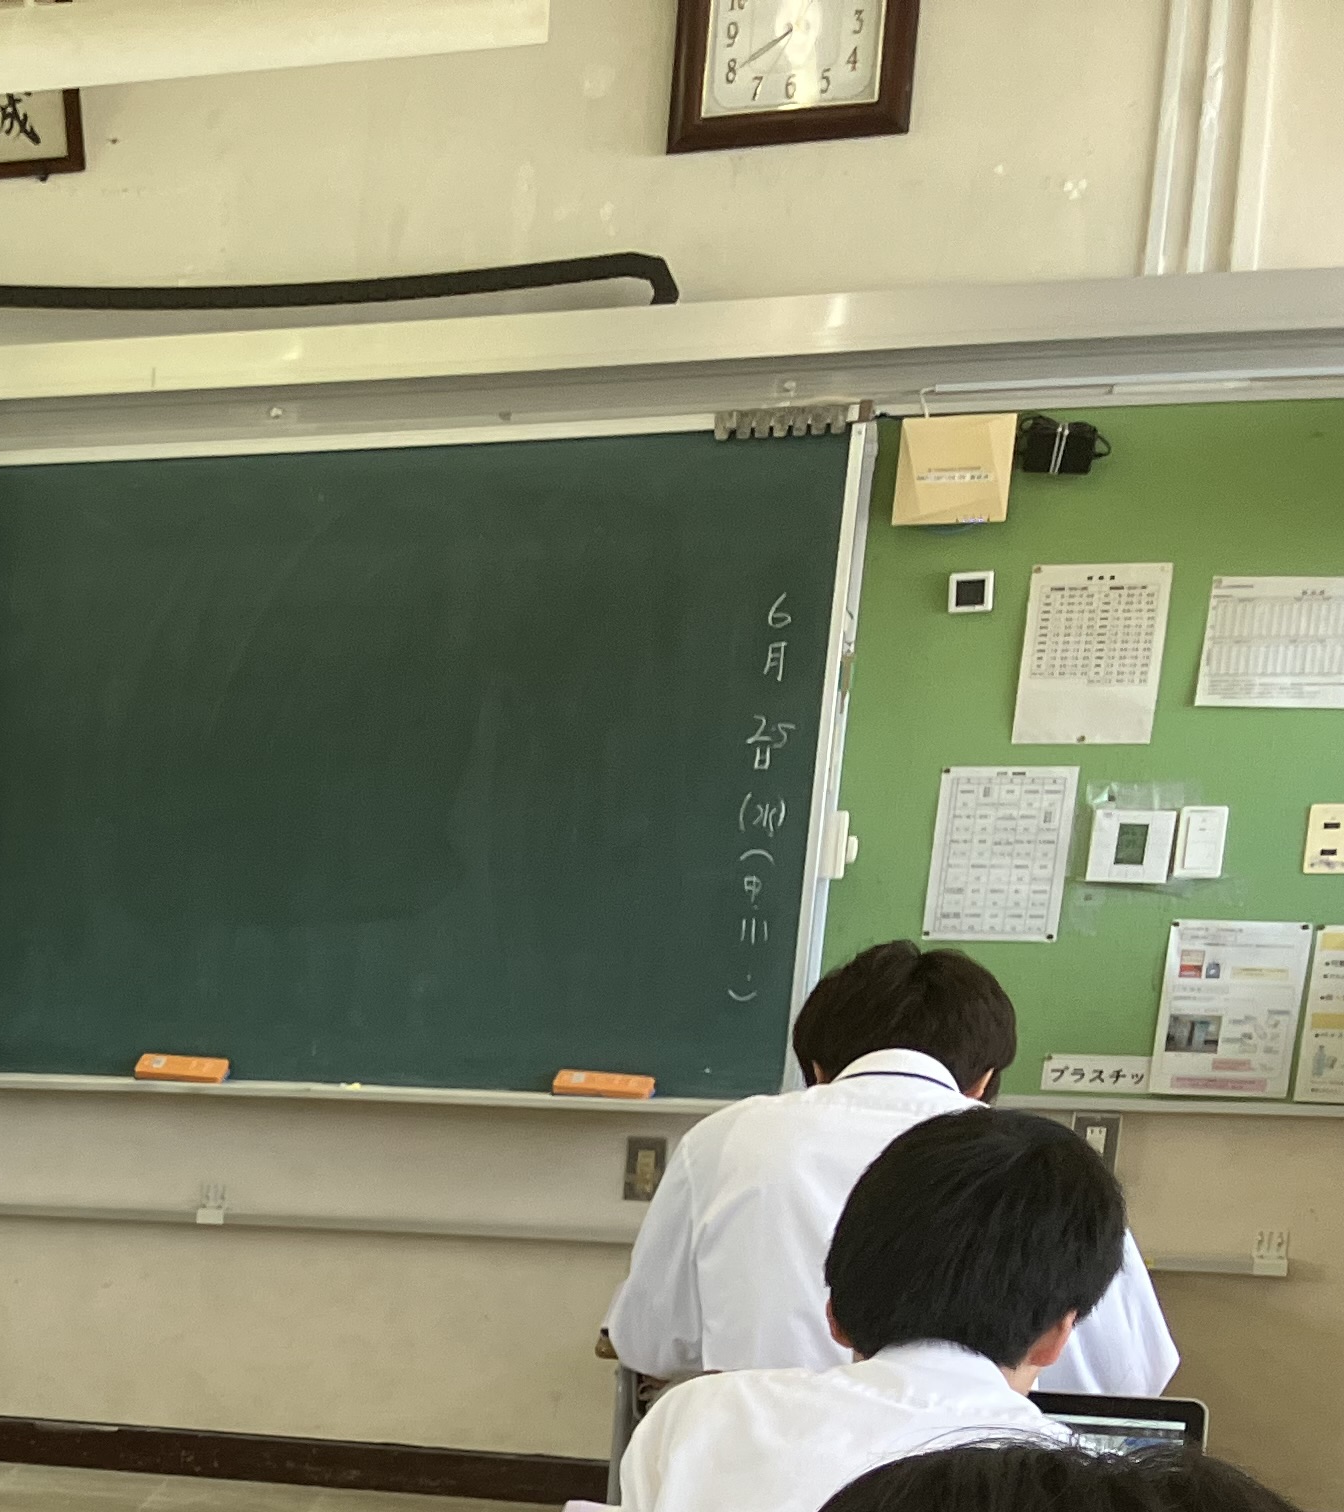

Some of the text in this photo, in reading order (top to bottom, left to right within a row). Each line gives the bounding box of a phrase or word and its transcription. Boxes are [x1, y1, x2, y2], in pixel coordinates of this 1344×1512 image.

[726, 21, 739, 48] 9
[725, 58, 737, 84] 8
[846, 46, 858, 72] 4
[751, 75, 763, 101] 7
[820, 68, 831, 94] 5
